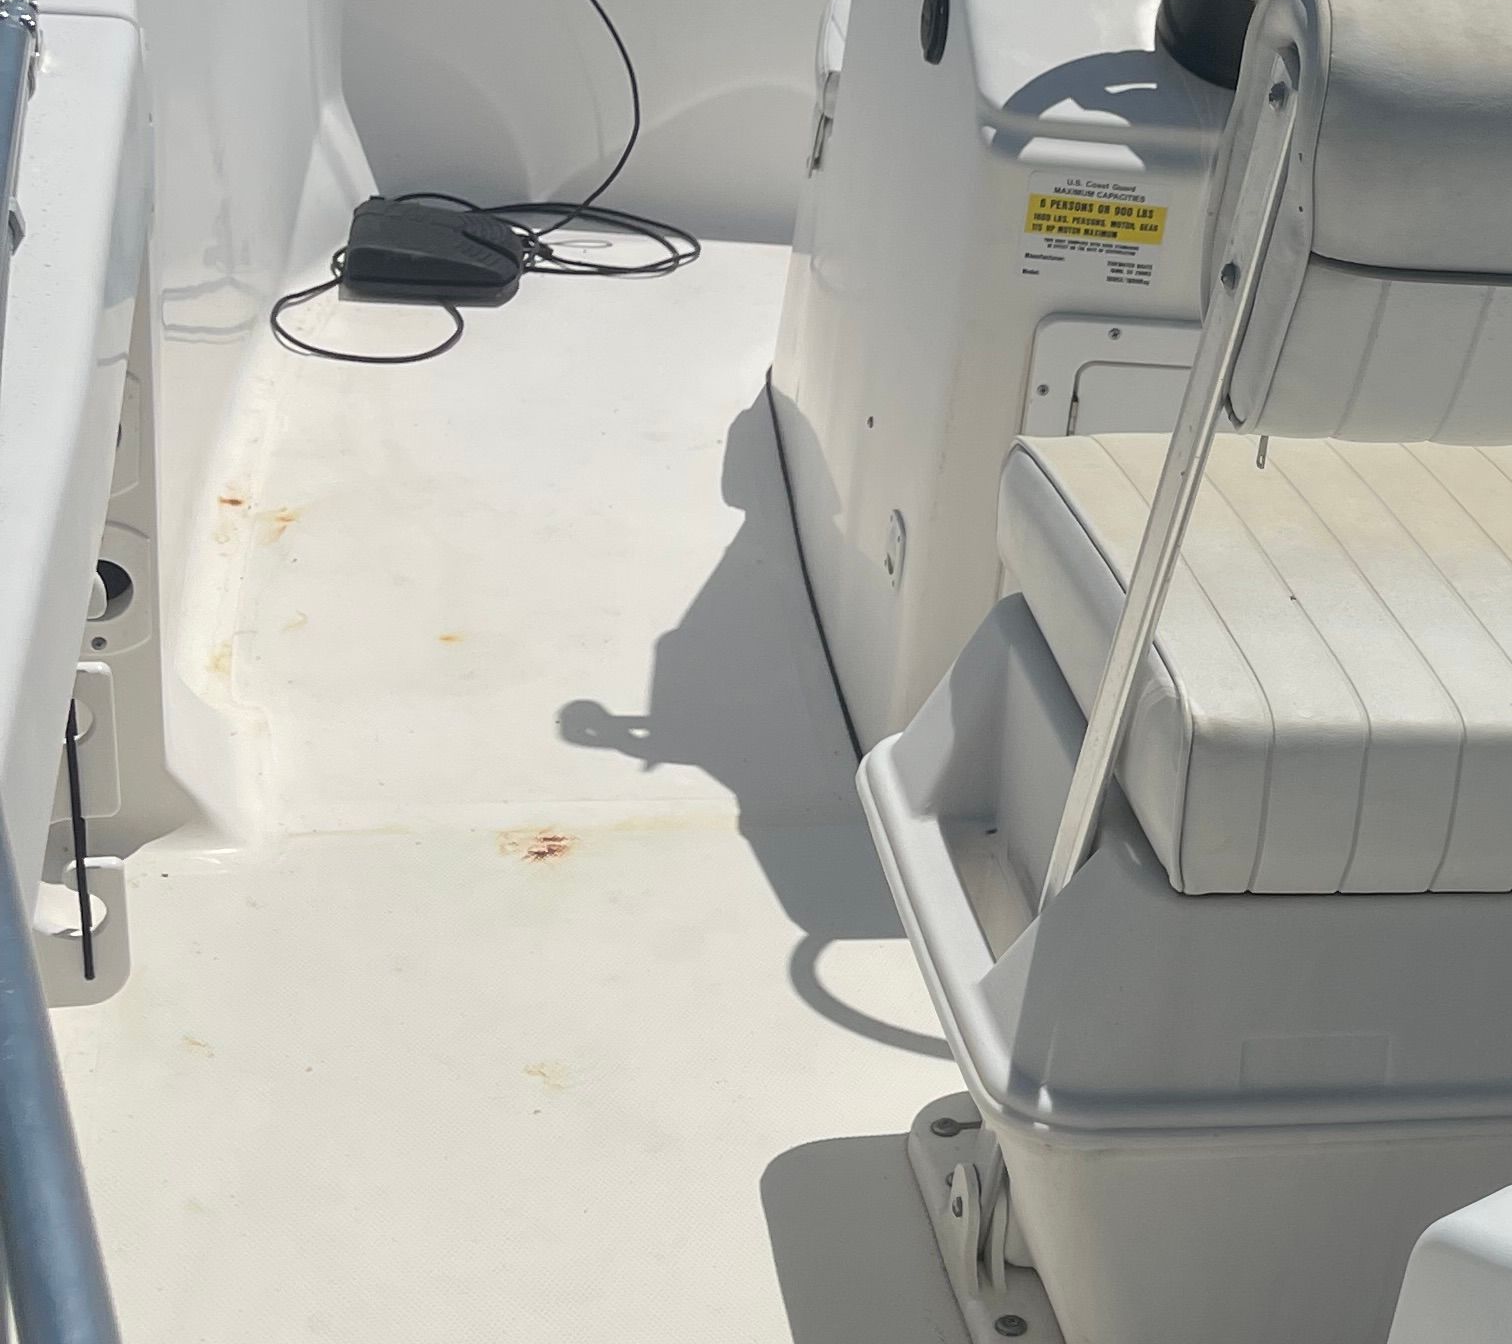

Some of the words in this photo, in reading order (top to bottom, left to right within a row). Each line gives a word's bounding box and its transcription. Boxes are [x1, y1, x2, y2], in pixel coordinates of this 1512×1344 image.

[1053, 186, 1095, 197] MAXIMUM
[1096, 191, 1146, 203] CAPACITIES
[1050, 199, 1093, 213] PERSONS
[1097, 204, 1110, 215] OR
[1114, 206, 1133, 217] 900
[1136, 208, 1154, 219] LBS
